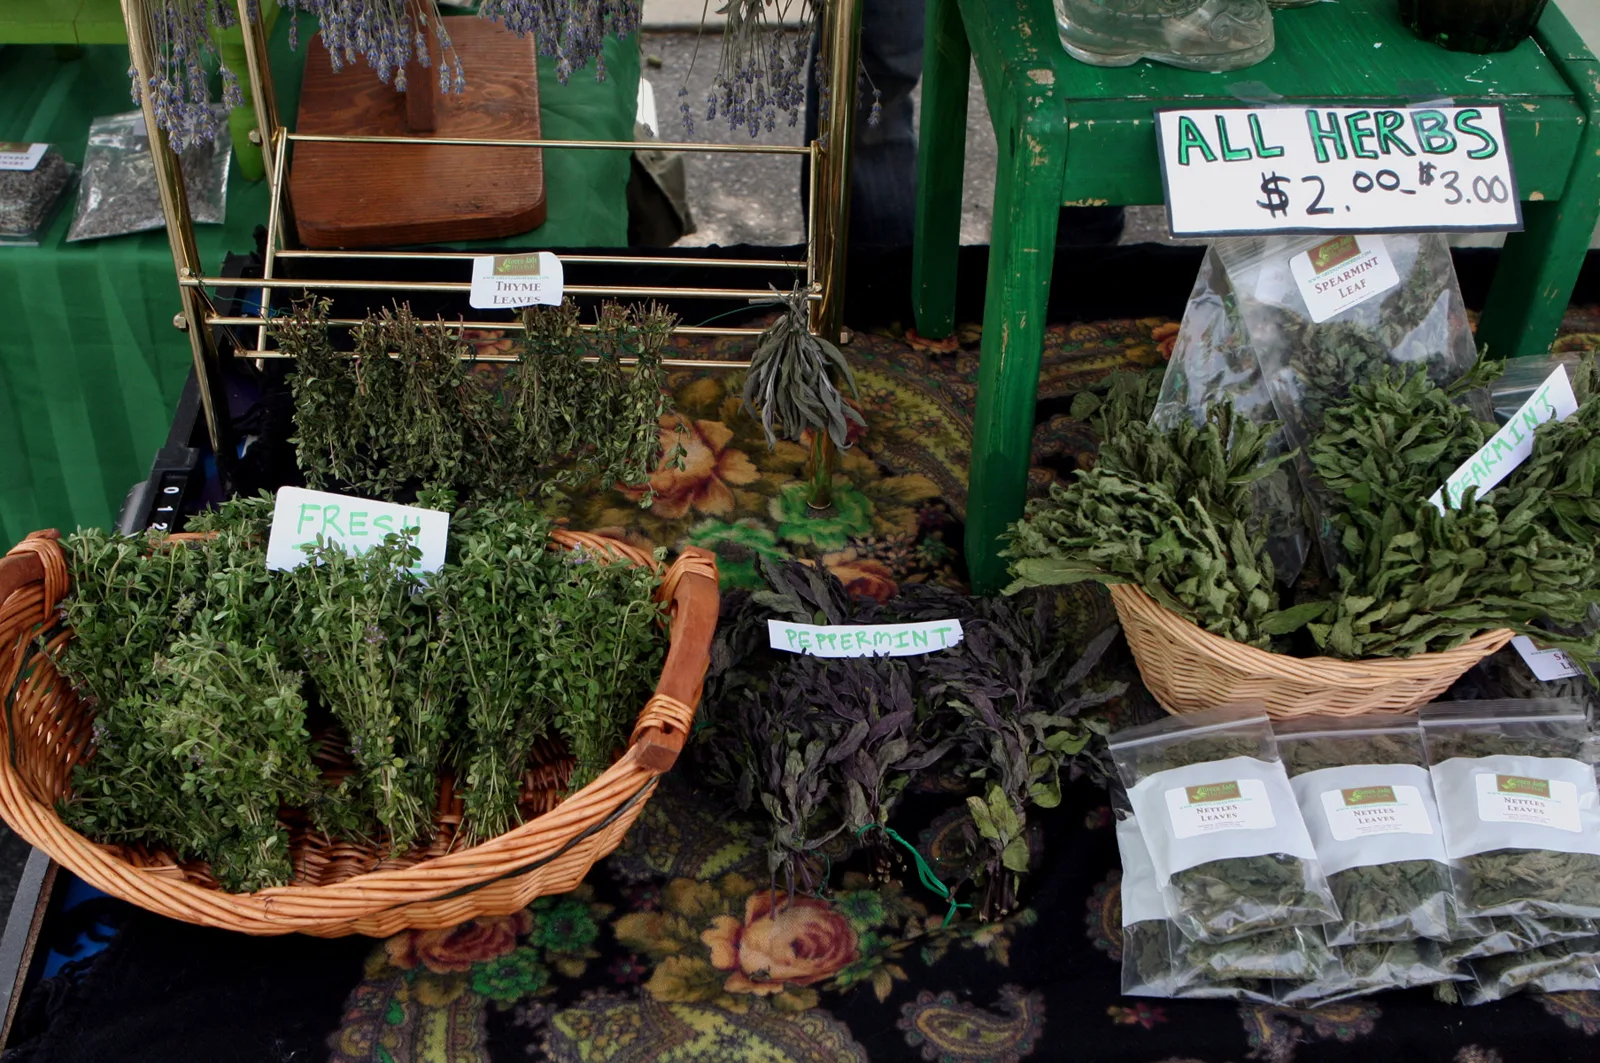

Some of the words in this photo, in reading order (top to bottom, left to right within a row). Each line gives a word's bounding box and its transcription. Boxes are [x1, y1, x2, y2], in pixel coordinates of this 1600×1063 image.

[1178, 113, 1285, 166] ALL
[1305, 108, 1499, 163] HERBS
[1314, 256, 1379, 294] SPEARMINT
[495, 281, 542, 292] THYME
[1339, 279, 1367, 299] LEAF
[493, 295, 541, 305] LEAVES
[1439, 385, 1551, 510] PEARMINT
[296, 502, 422, 547] FRESH
[784, 626, 952, 651] PEPPERMINT
[1503, 797, 1546, 808] NETTLES
[1196, 804, 1238, 814] NETTLES
[1352, 807, 1395, 817] NETTLES
[1507, 805, 1545, 815] LEAVES
[1200, 812, 1238, 822] LEAVES
[1358, 816, 1396, 825] LEAVES
